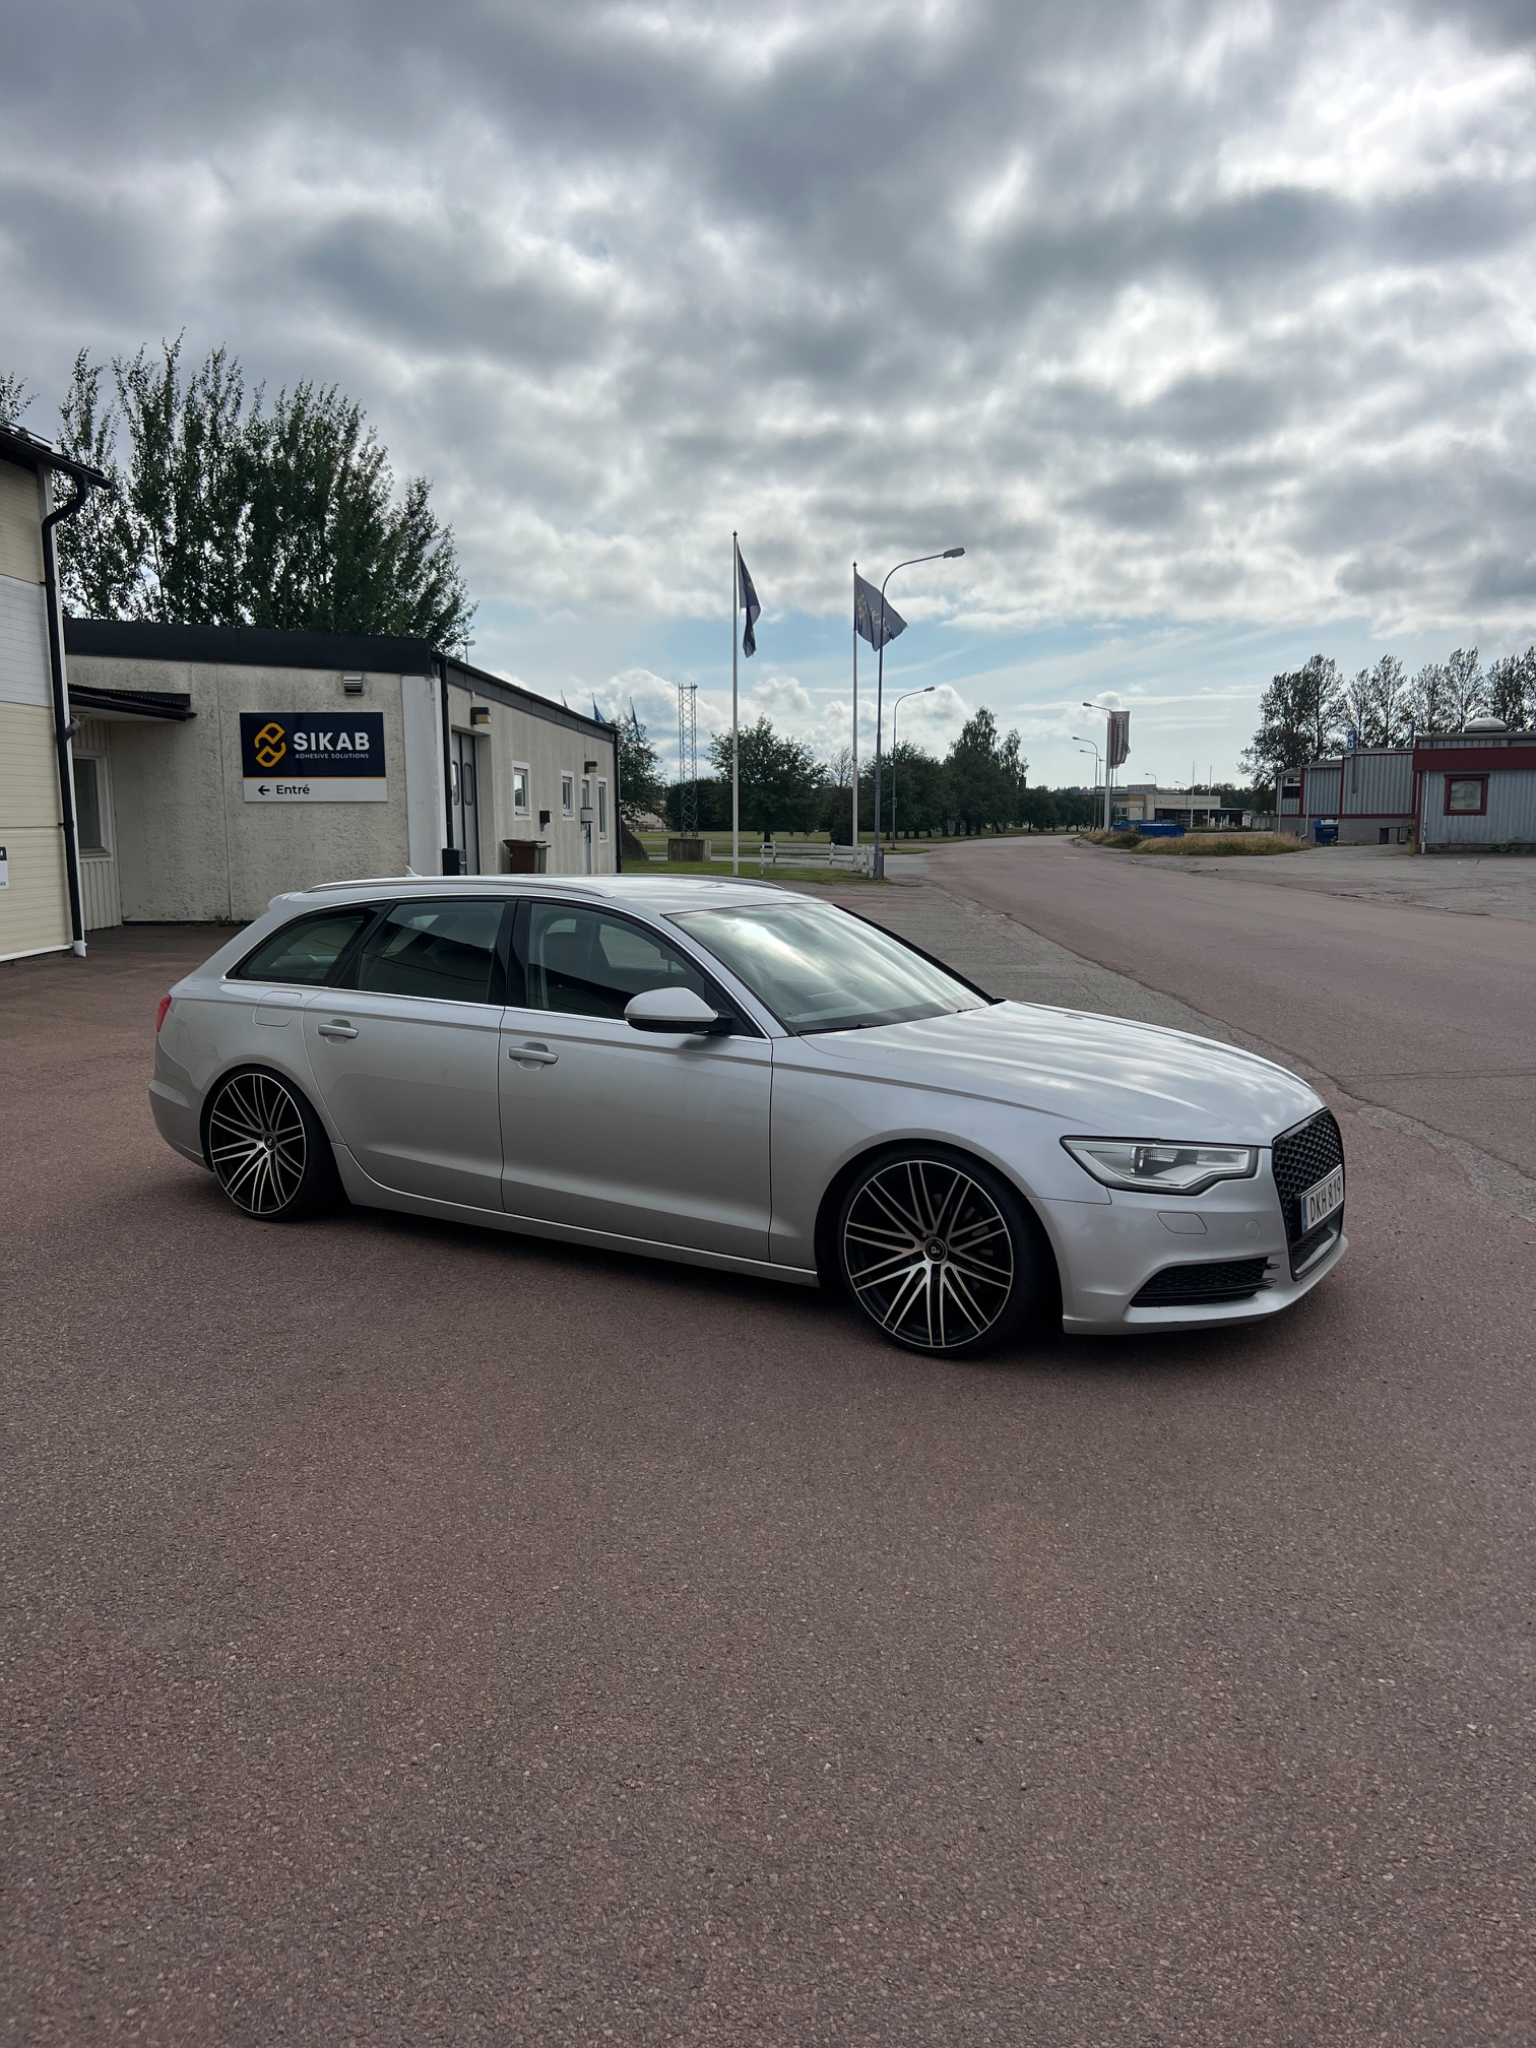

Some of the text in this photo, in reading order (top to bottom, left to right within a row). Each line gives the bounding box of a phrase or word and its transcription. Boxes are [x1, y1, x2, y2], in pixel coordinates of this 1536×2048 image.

[293, 732, 370, 751] SIKAB
[276, 784, 310, 795] Entré
[1309, 1187, 1327, 1223] DKH
